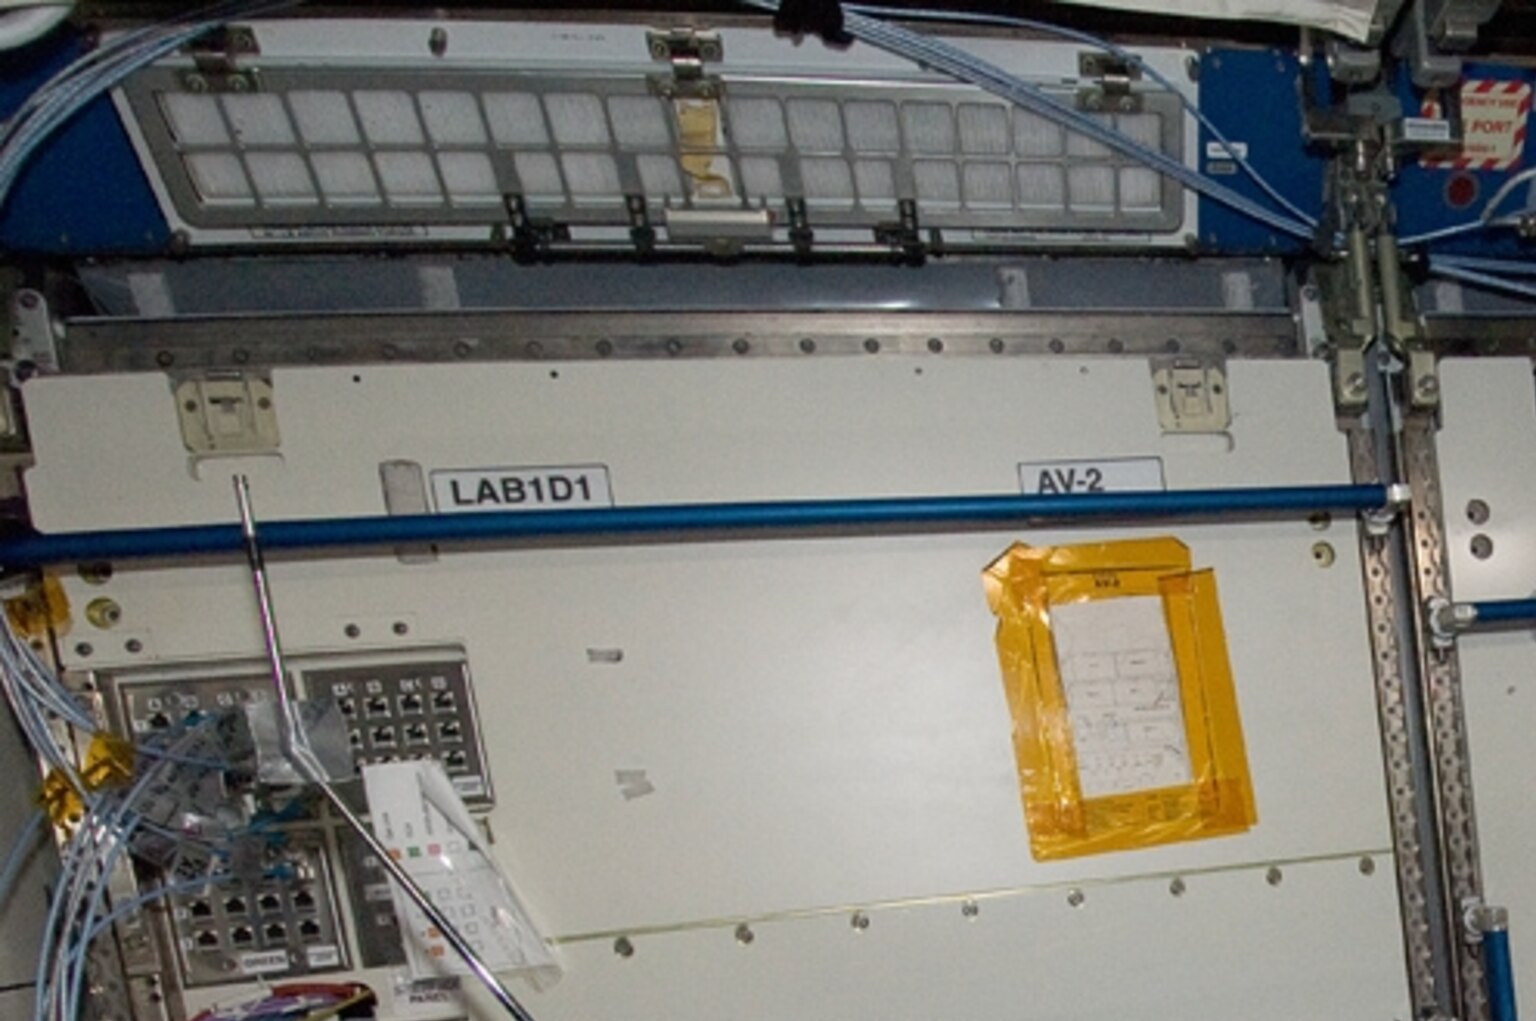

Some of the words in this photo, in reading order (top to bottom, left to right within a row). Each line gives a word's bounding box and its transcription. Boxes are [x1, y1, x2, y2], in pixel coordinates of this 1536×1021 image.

[1471, 120, 1513, 135] PORT
[450, 474, 592, 508] LAB1D1
[1036, 466, 1106, 494] AV-2
